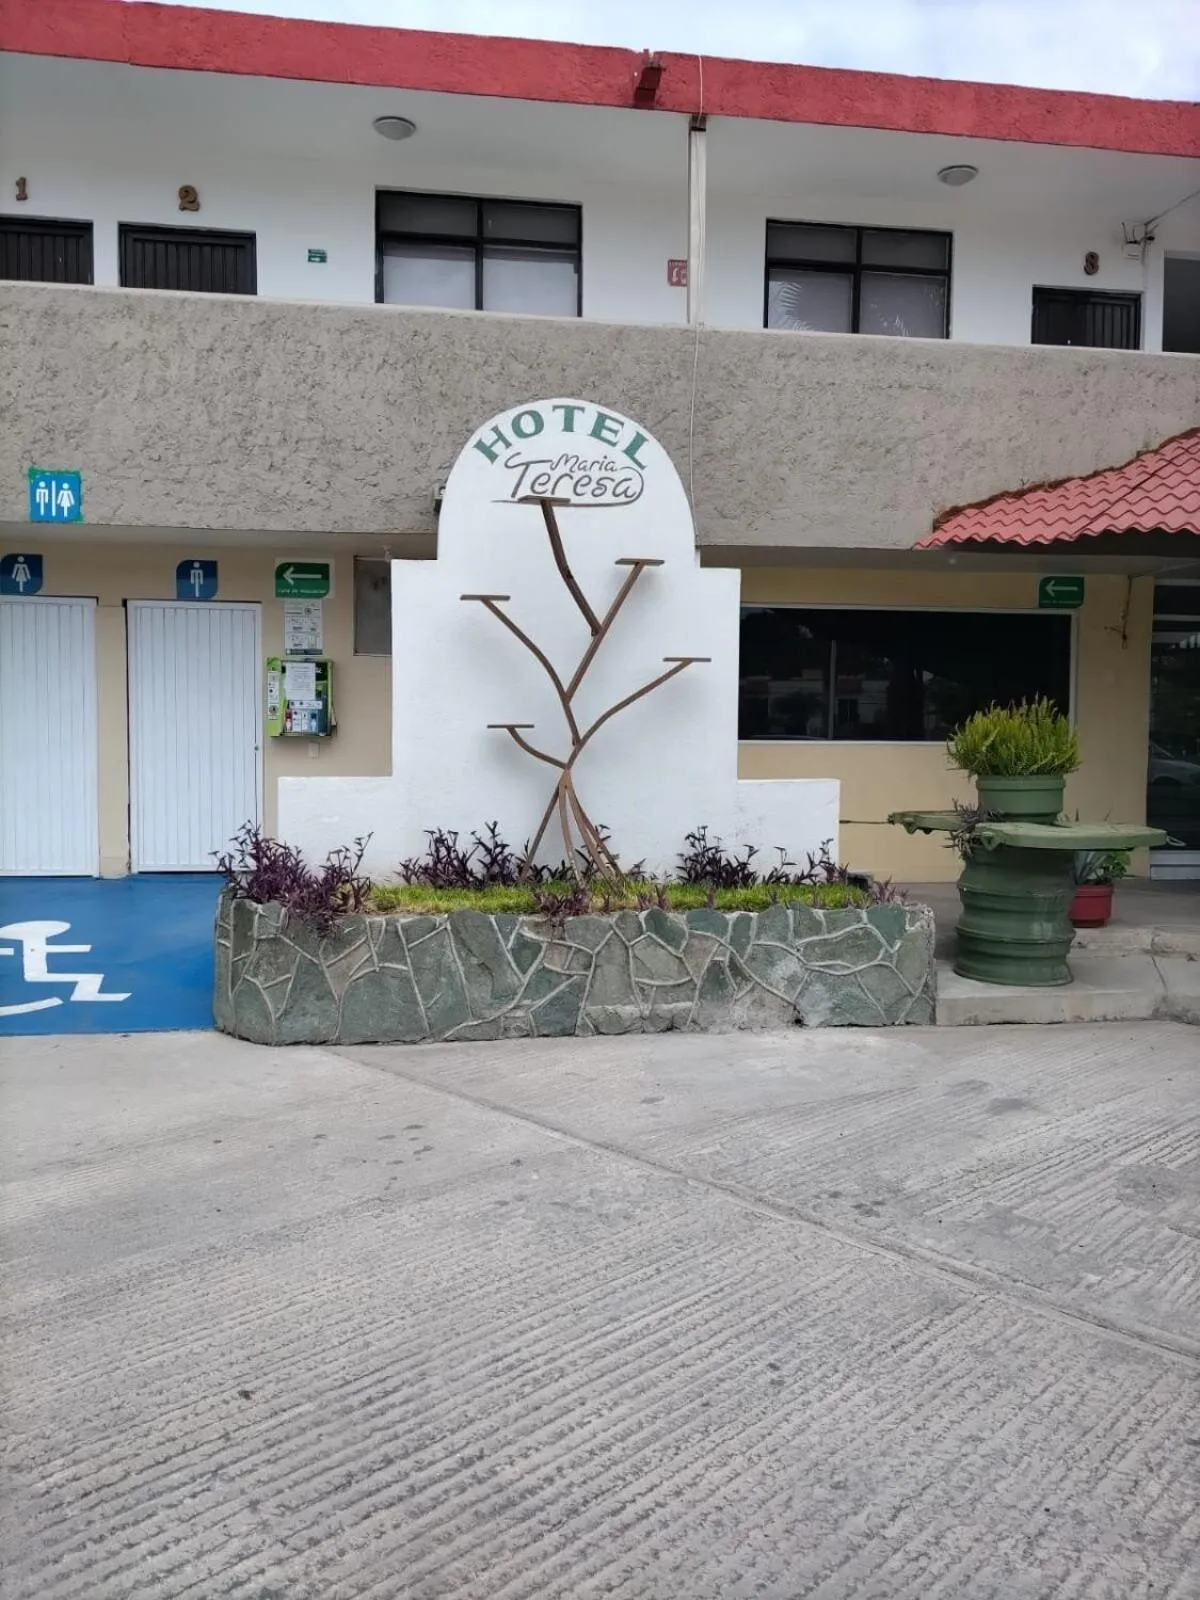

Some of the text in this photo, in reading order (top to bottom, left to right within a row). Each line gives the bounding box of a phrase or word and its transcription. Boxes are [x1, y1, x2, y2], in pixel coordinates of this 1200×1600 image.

[16, 177, 28, 201] 1
[178, 185, 200, 211] 2
[1084, 251, 1099, 275] 8
[473, 404, 649, 470] HOTEL
[504, 452, 642, 499] Teresa
[551, 453, 617, 473] Maria
